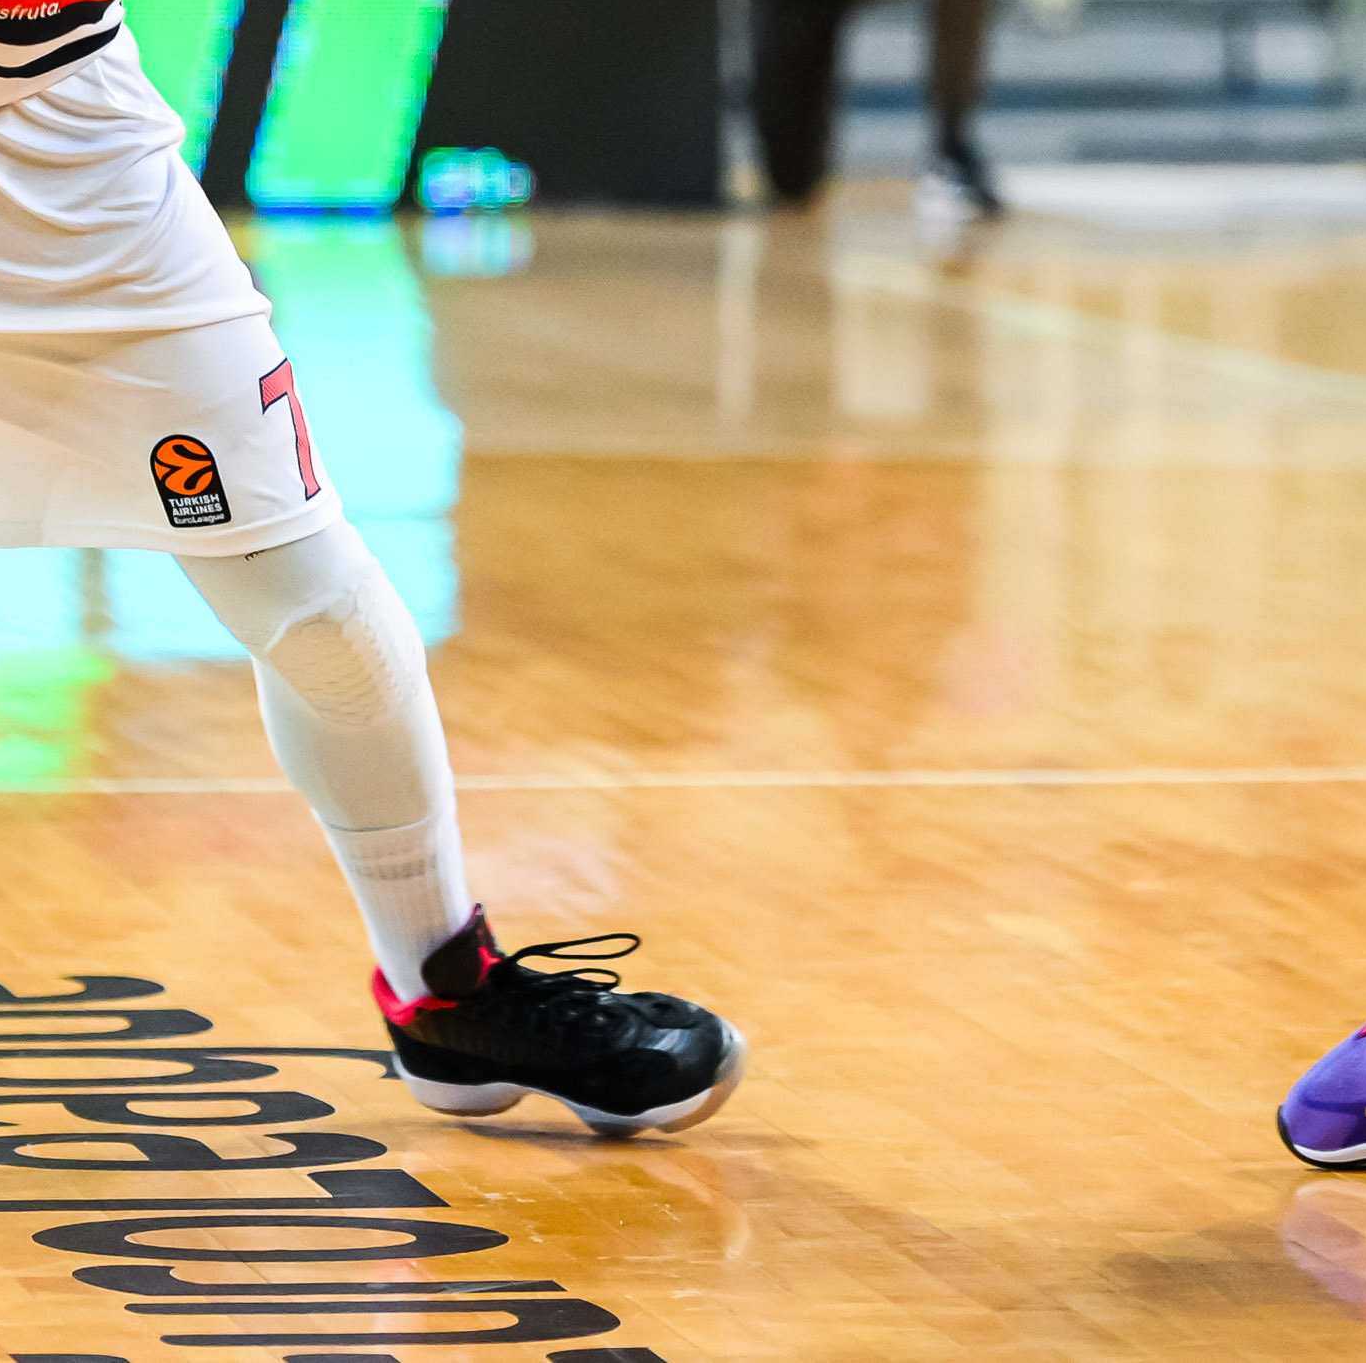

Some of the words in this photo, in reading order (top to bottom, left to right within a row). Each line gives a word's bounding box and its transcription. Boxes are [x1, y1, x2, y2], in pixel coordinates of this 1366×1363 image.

[258, 357, 322, 502] 7
[167, 493, 220, 508] TURKISH
[172, 502, 223, 517] AIRLINES
[173, 513, 225, 525] EuroLeague
